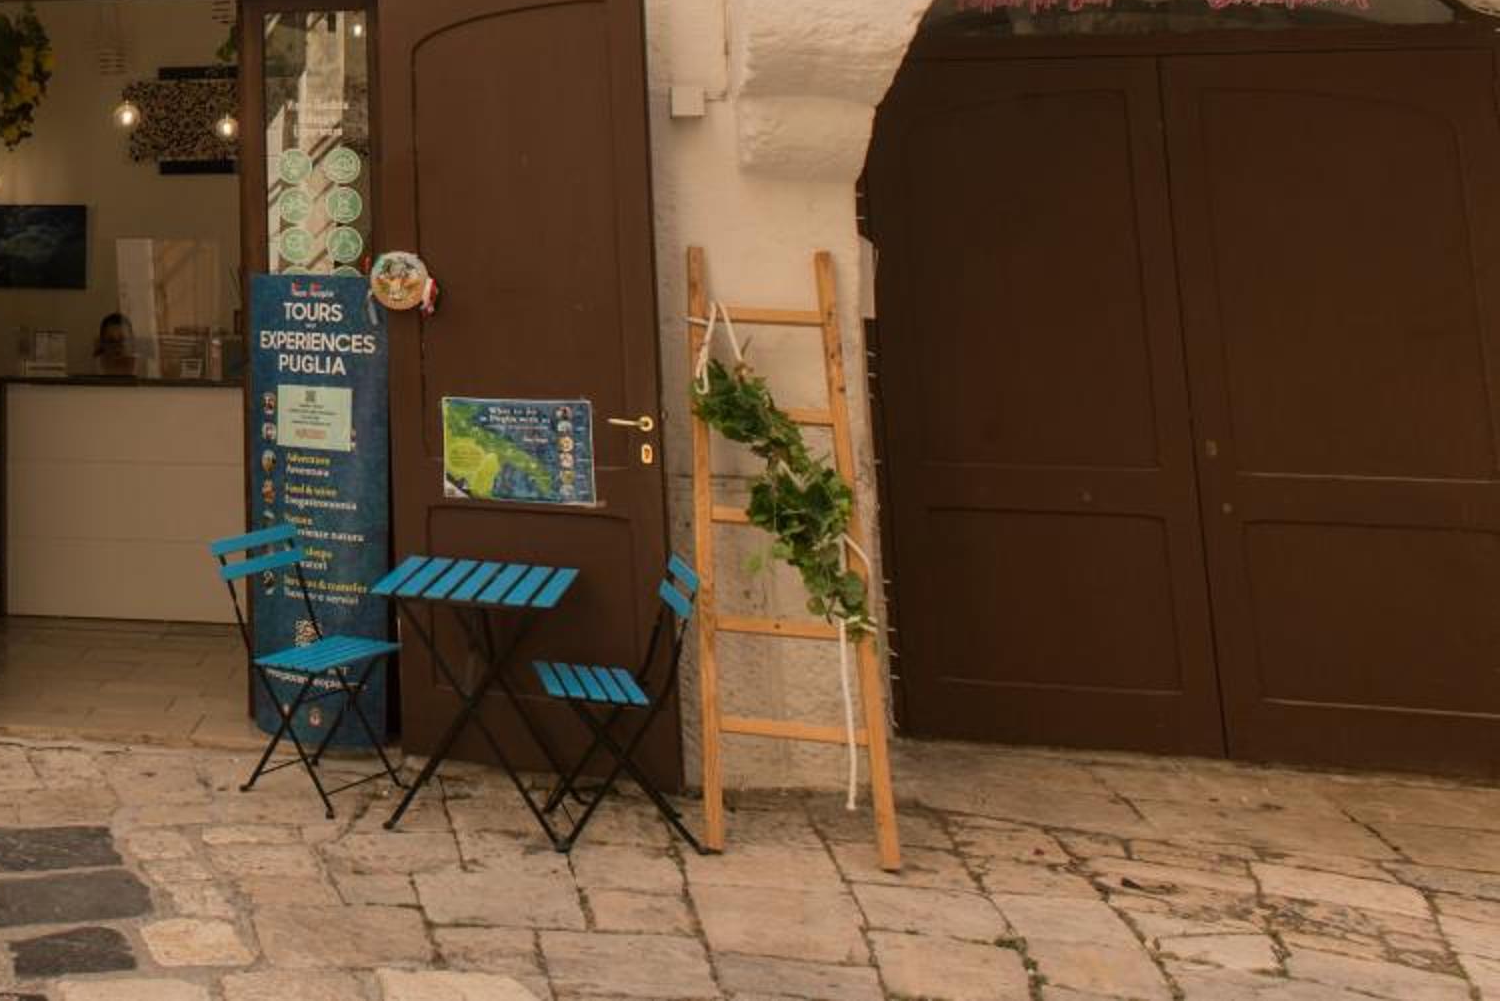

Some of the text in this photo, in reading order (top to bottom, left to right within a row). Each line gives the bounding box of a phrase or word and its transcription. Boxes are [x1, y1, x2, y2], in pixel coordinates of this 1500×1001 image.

[283, 302, 343, 322] TOURS
[260, 330, 377, 354] EXPERIENCES
[278, 354, 347, 376] PUGLIA
